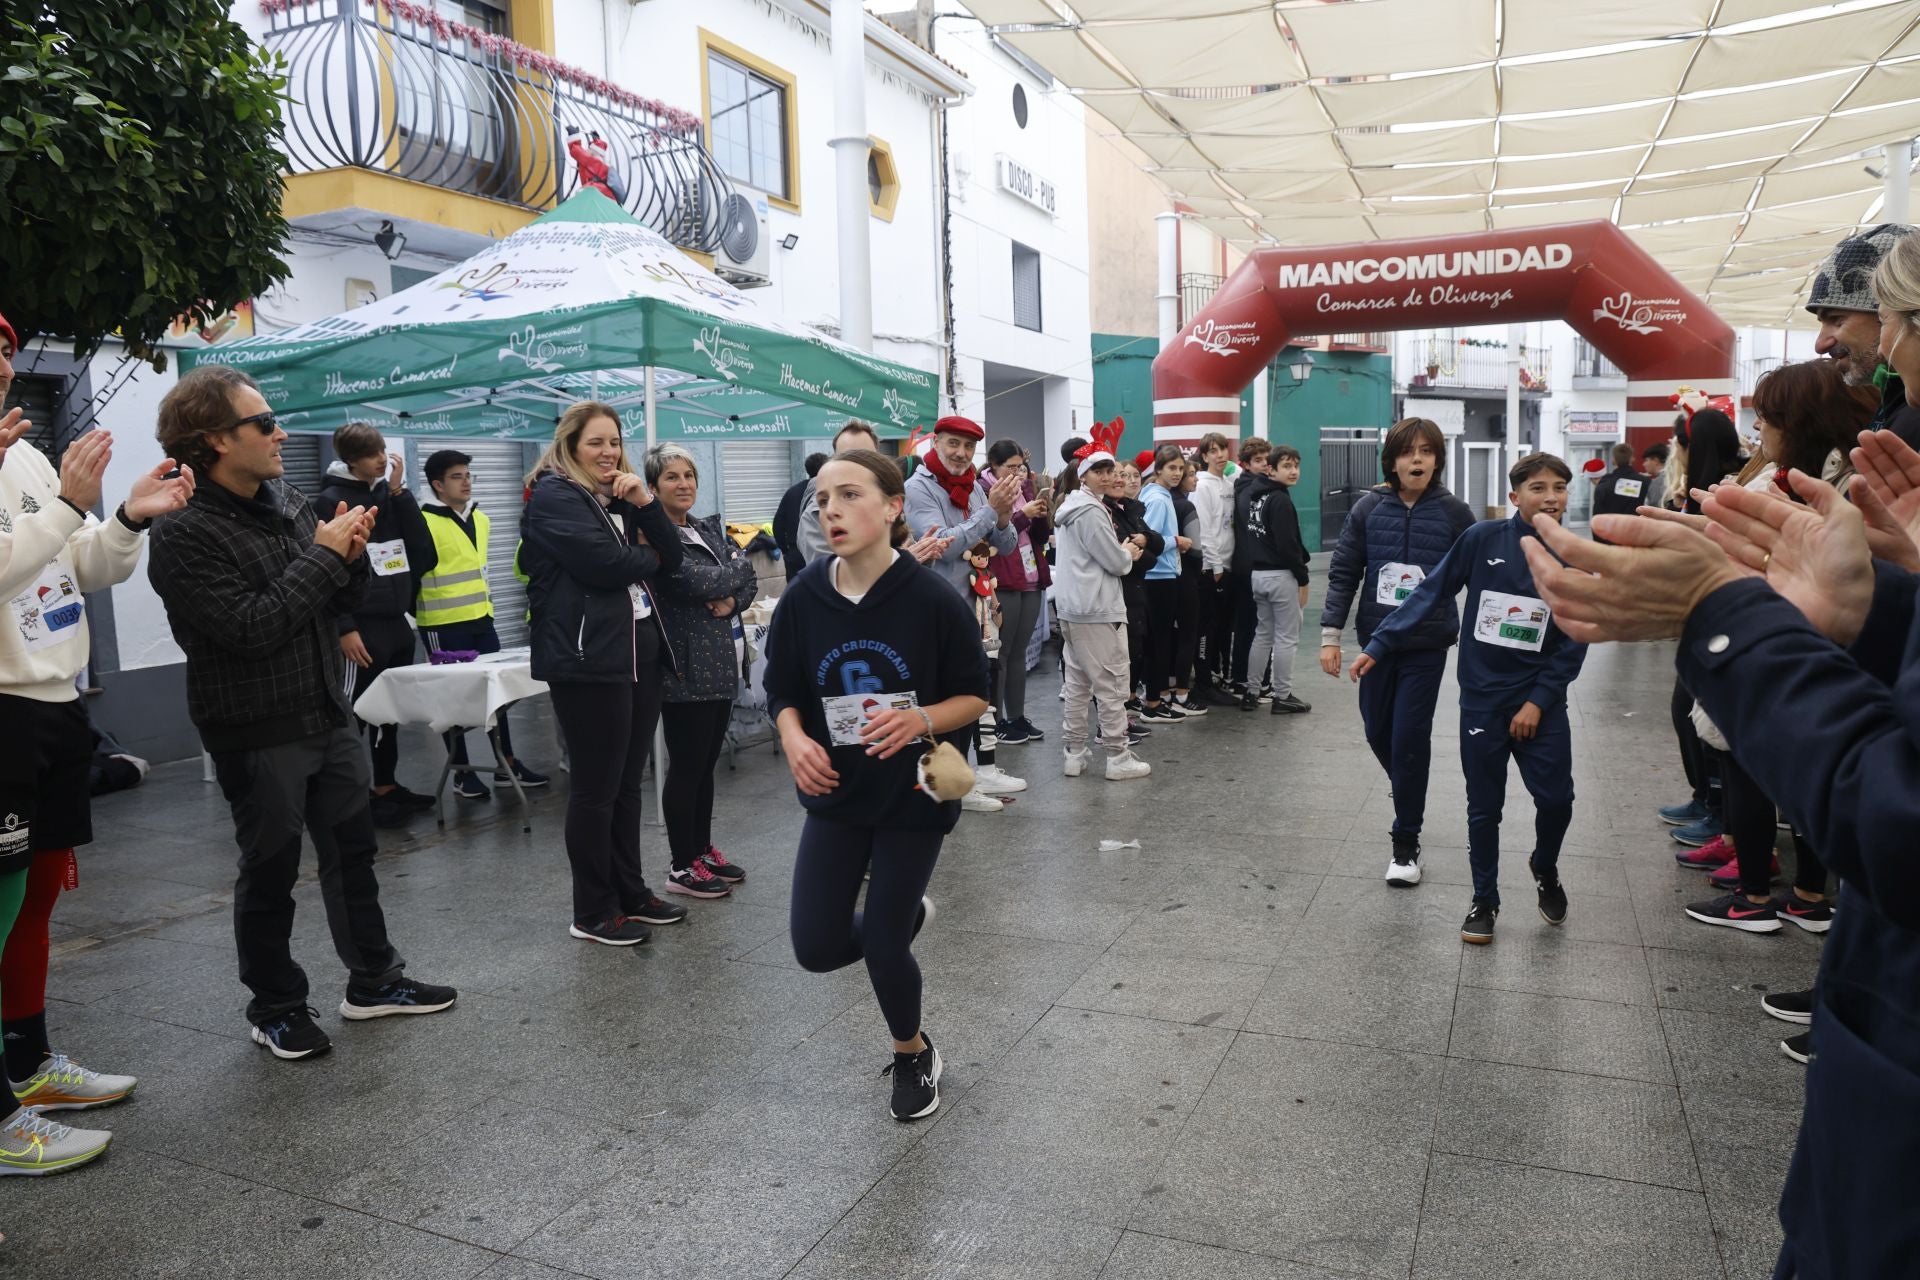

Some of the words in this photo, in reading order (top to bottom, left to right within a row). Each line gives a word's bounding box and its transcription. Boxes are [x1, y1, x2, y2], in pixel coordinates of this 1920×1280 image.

[1009, 161, 1032, 199] DISCO
[1041, 181, 1055, 212] PUB
[1279, 243, 1573, 289] MANCOMUNIDAD
[1316, 293, 1396, 312] Comarca
[1403, 287, 1423, 307] de
[1429, 284, 1514, 309] Olivenza
[842, 640, 911, 680] CRUCIFICADO
